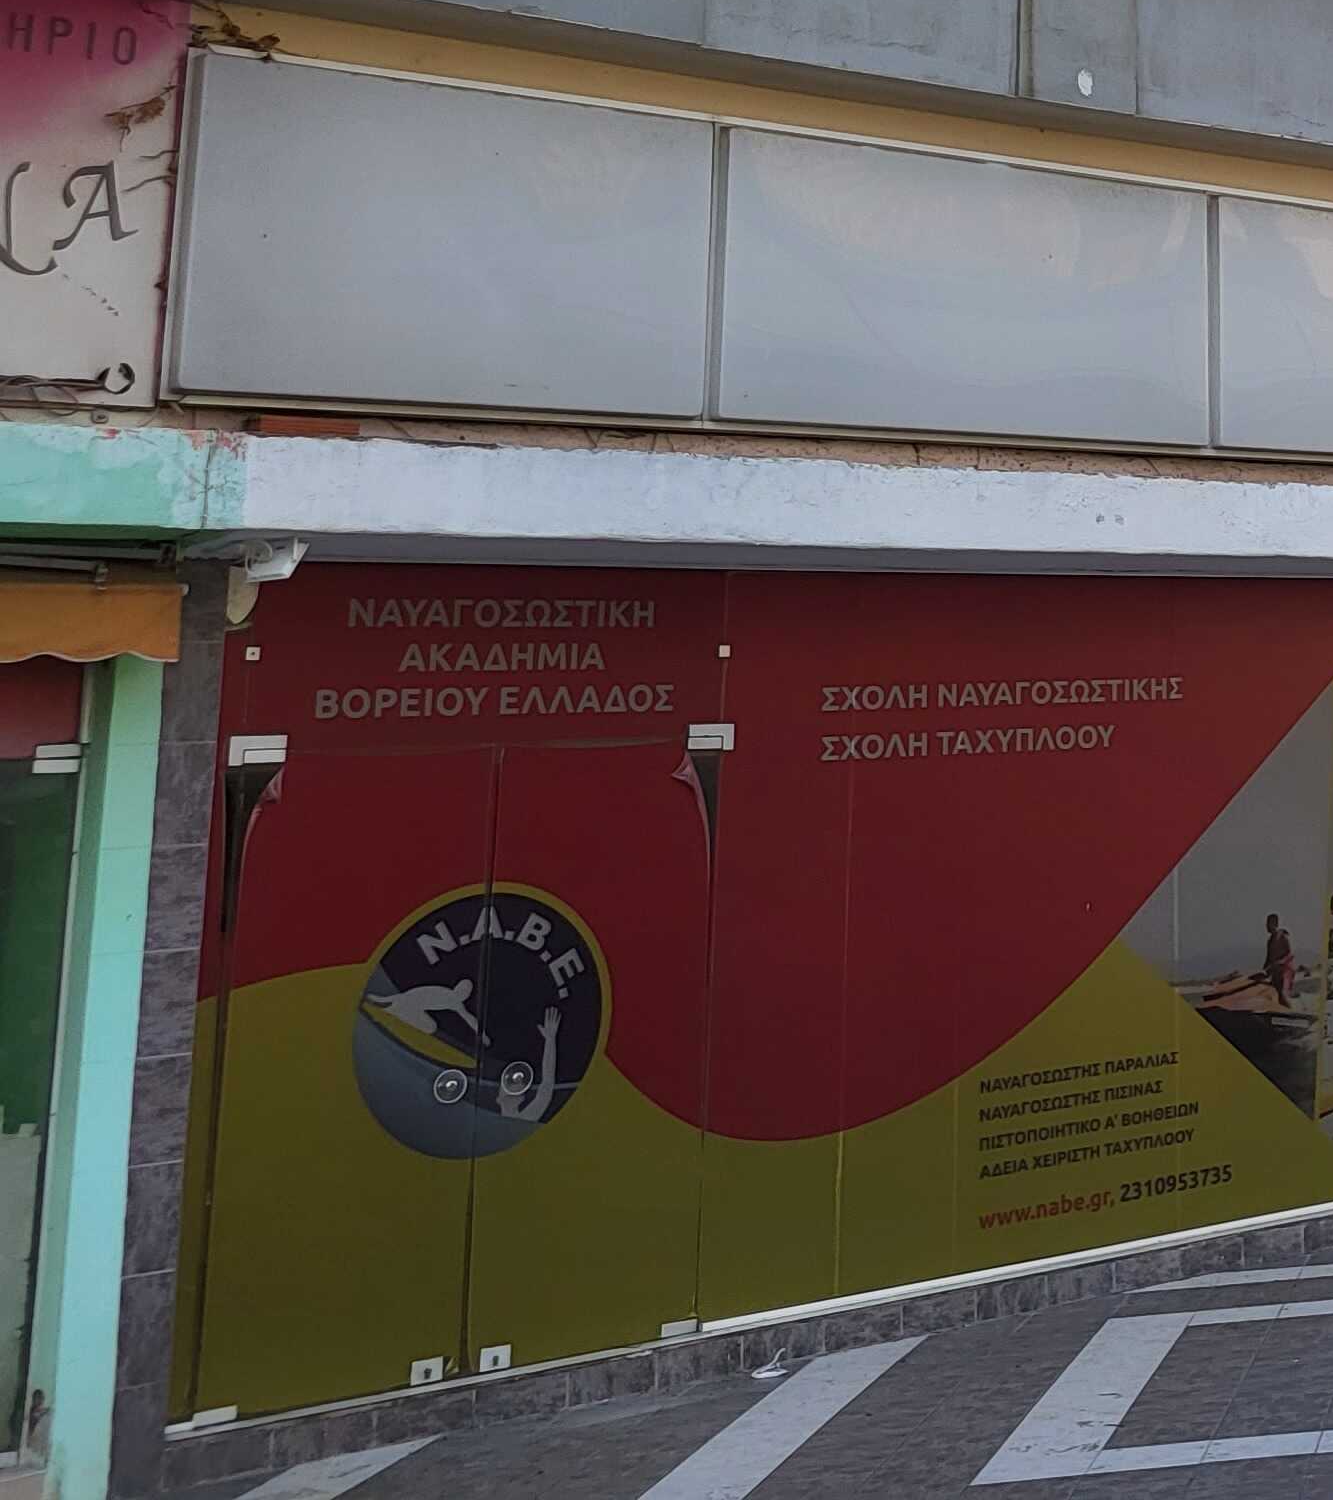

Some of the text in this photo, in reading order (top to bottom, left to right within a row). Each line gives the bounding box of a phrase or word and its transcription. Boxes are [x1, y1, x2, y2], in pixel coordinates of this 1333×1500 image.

[347, 598, 656, 629] ΝΑΥΑΓΟΣΩΣΤΙΚΗ
[398, 642, 606, 672] ΑΚΑΔΗΜΙΑ
[313, 683, 676, 720] ΒΟΡΕΙΟΥ ΕΛΛΑΔΟΣ
[819, 676, 1185, 713] ΣΧΟΛΗ ΝΑΥΑΓΟΣΩΣΤΙΚΗΣ
[819, 724, 1116, 762] ΣΧΟΛΗ ΤΑΧΥΠΛΟΟΥ
[979, 1051, 1180, 1094] ΝΑΥΑΓΟΣΩΣΤΗΣ ΠΑΡΑΛΙΑΣ
[979, 1079, 1164, 1122] ΝΑΥΑΓΟΣΩΣΤΗΣ ΠΙΣΙΝΑΣ
[979, 1118, 1101, 1151] ΠΙΣΤΟΠΟΙΗΤΙΚΟ
[1121, 1101, 1200, 1128] ΒΟΗΘΕΙΩΝ
[978, 1128, 1196, 1180] ΑΔΕΙΑ ΧΕΙΡΙΣΤΗ ΤΑΧΥΠΛΟΟΥ
[1119, 1164, 1233, 1203] 2310953735
